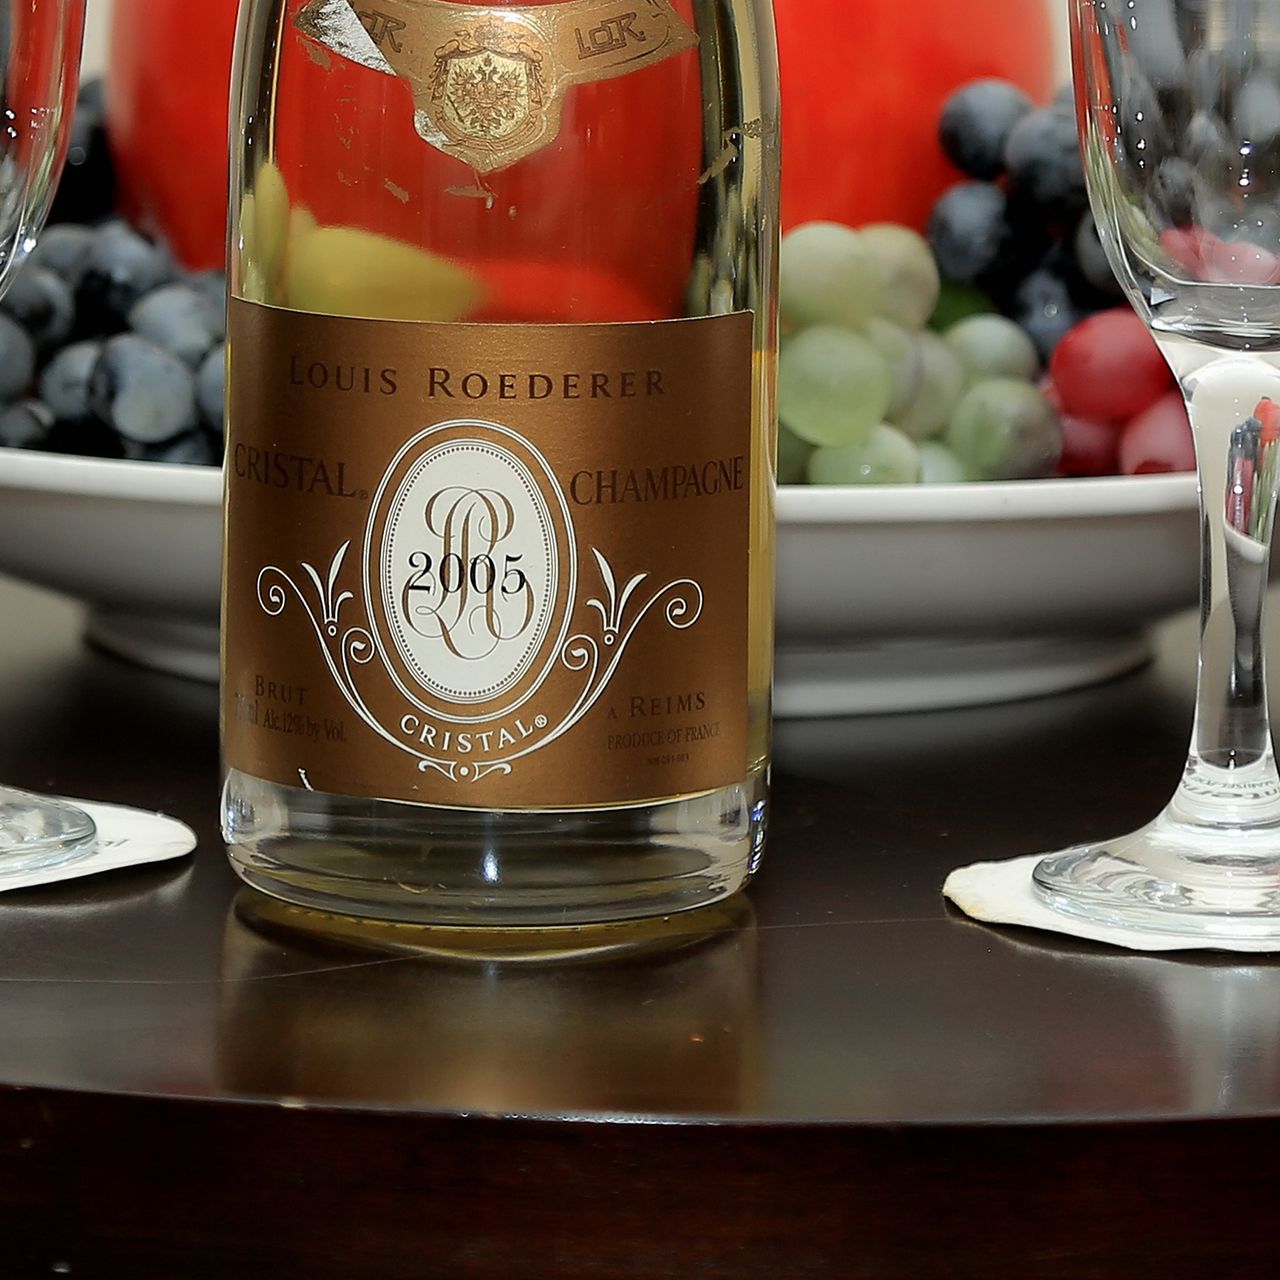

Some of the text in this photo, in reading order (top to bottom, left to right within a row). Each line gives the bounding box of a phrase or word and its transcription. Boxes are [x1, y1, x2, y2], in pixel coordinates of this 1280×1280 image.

[290, 355, 666, 402] LOUIS ROEDERER
[569, 455, 745, 506] CHAMPAGNE
[407, 551, 528, 596] 2005
[255, 674, 309, 706] BRUT
[630, 691, 706, 719] REIMS
[607, 721, 721, 750] PRODUCE OF FRANCE
